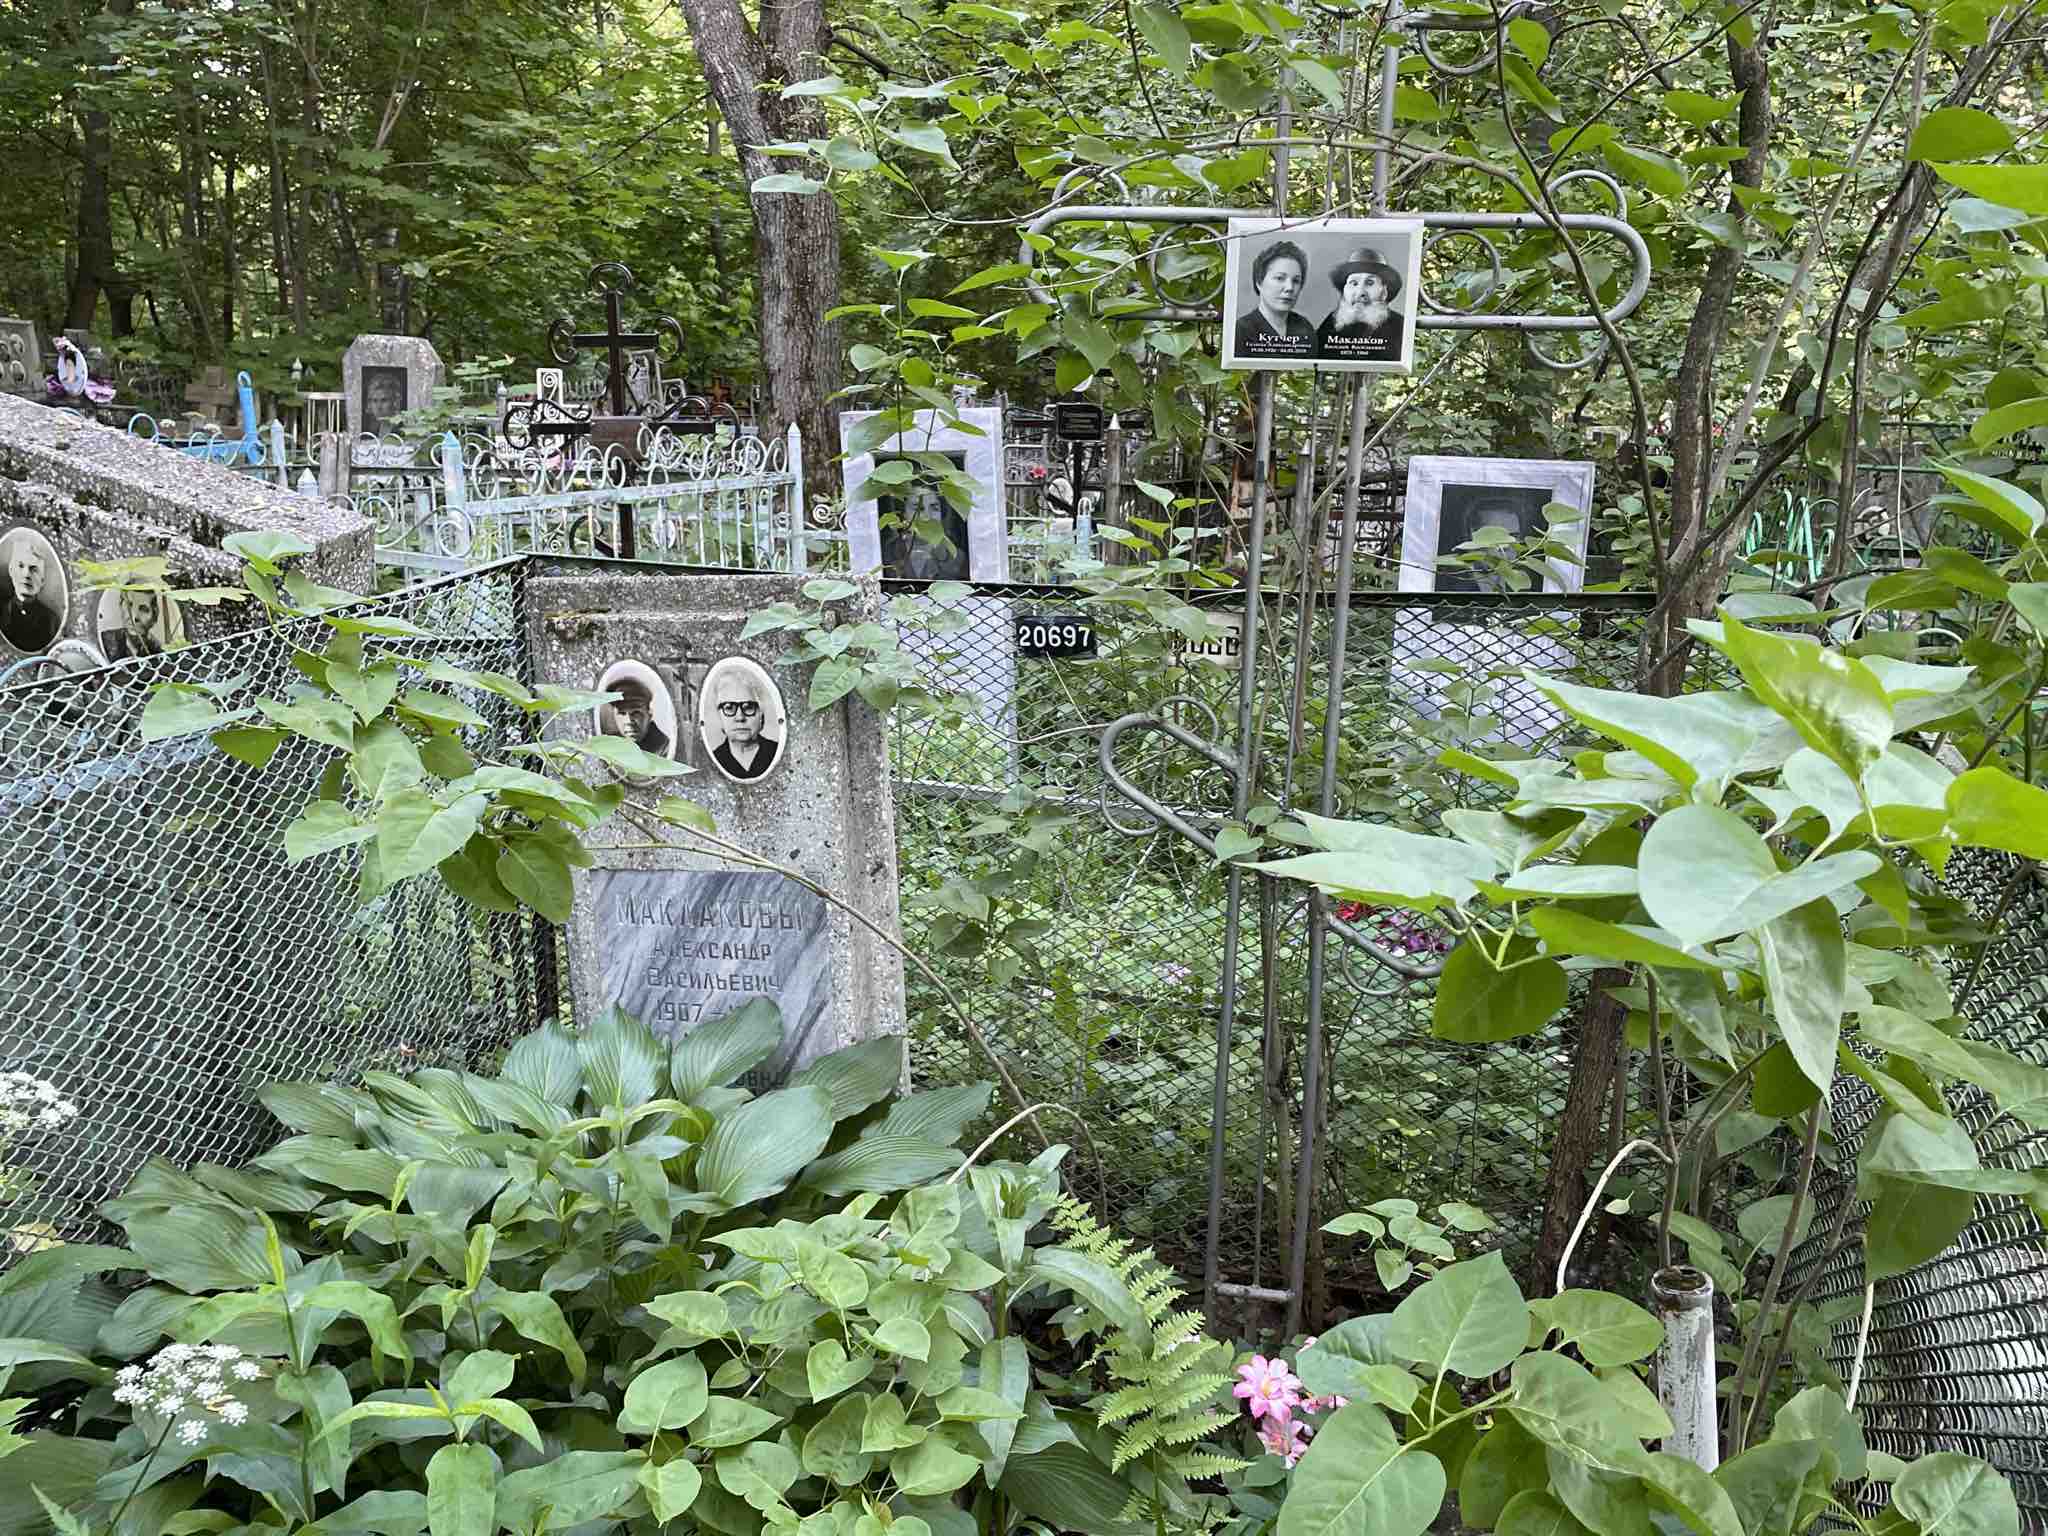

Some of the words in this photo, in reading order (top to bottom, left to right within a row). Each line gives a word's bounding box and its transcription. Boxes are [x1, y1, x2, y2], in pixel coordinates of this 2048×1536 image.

[1259, 333, 1300, 345] Кутчер
[1328, 335, 1384, 345] Маклаков
[1018, 625, 1091, 648] 20697
[648, 967, 784, 993] ВАСИЛЬЕВИЧ
[657, 1000, 703, 1023] 1907
